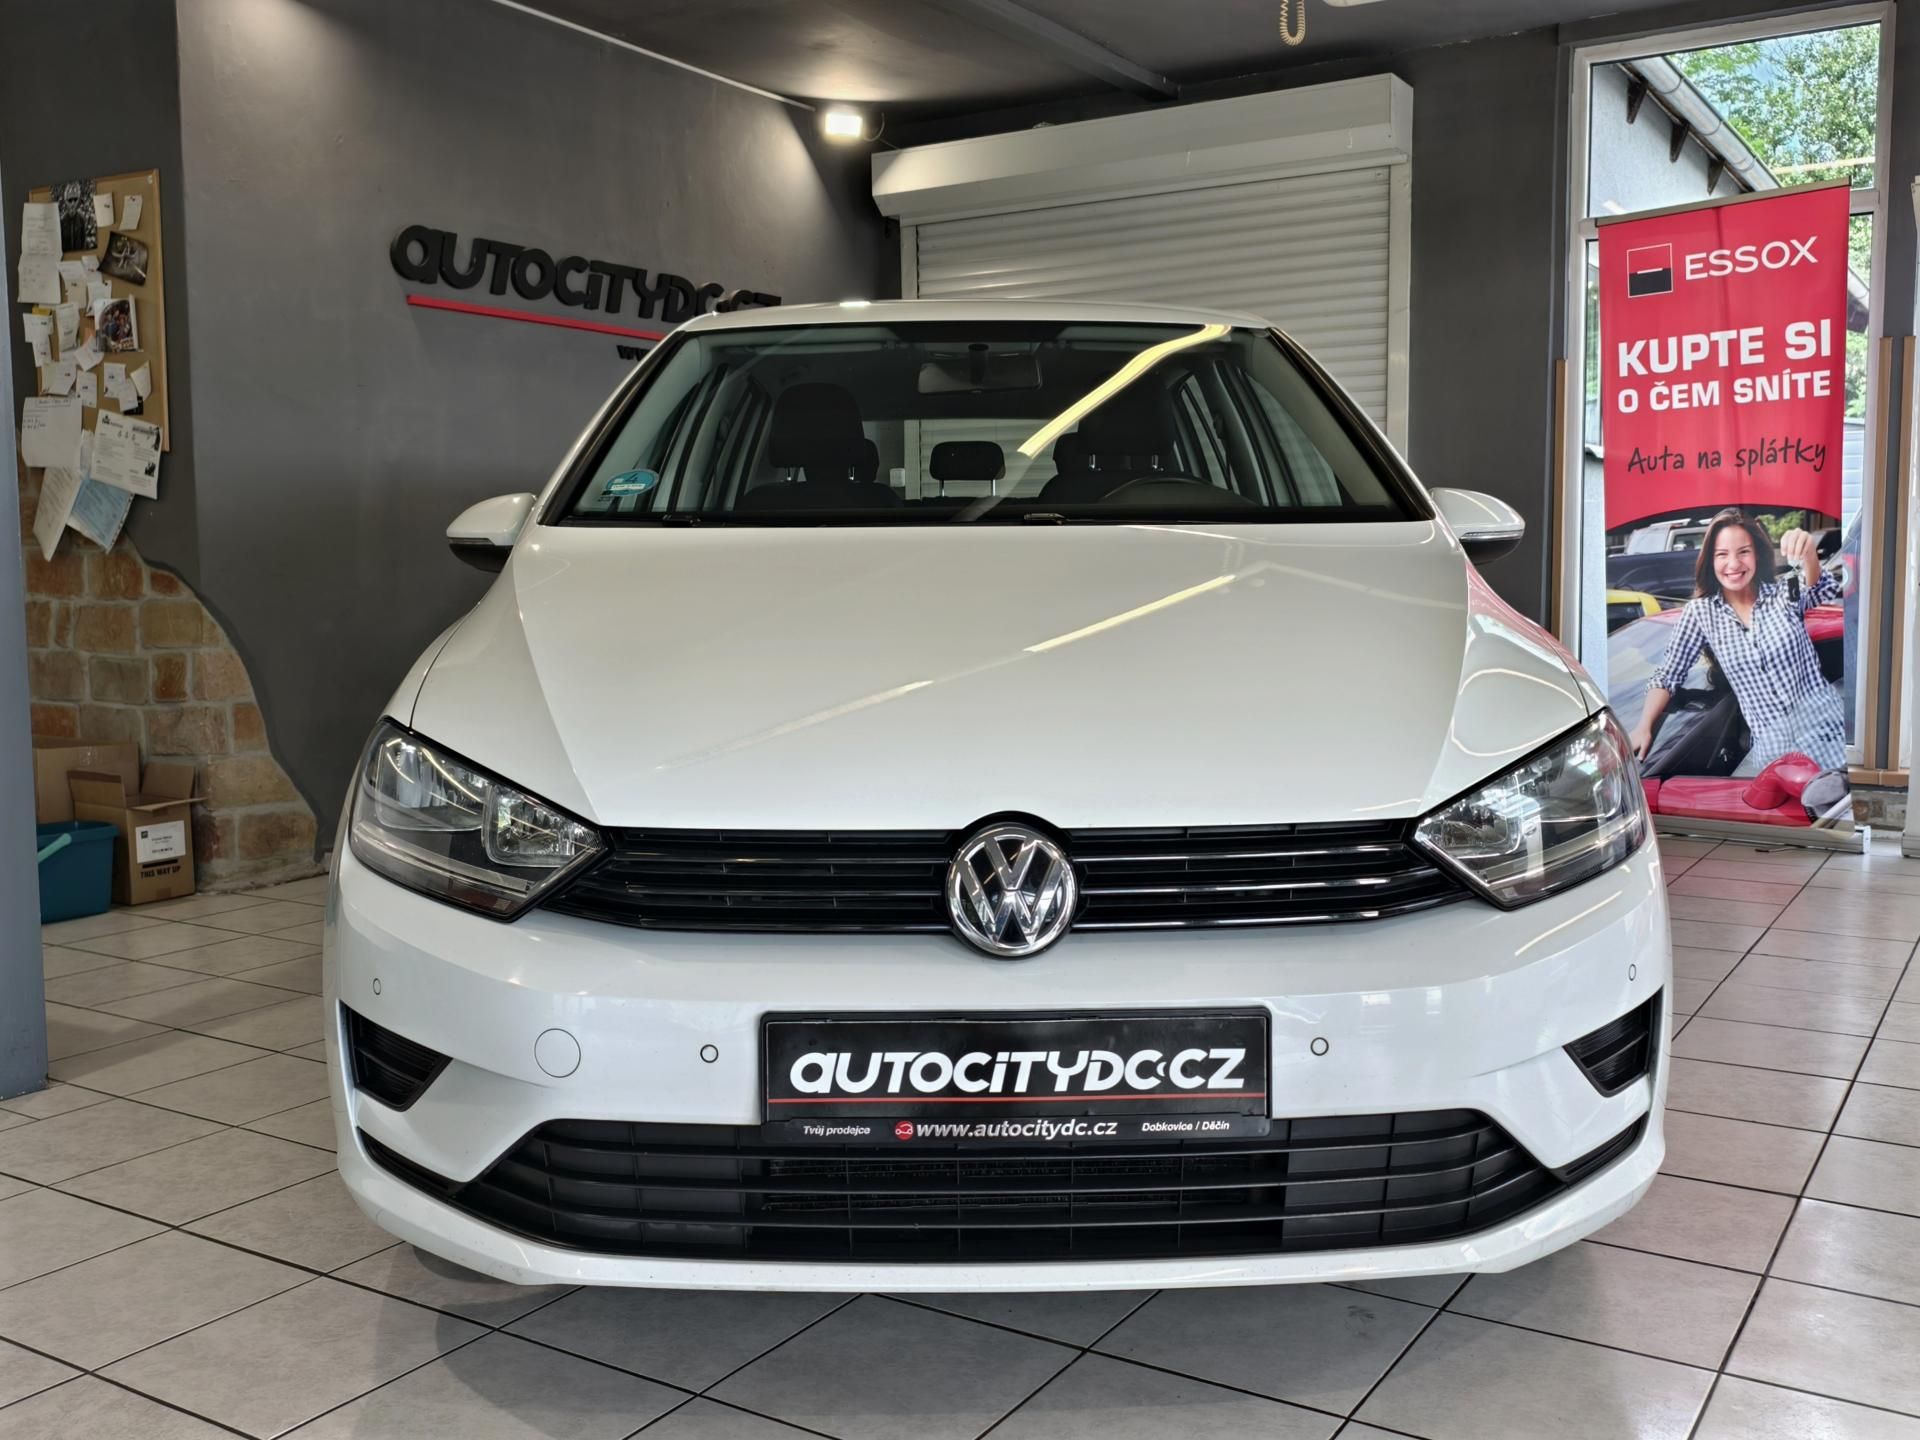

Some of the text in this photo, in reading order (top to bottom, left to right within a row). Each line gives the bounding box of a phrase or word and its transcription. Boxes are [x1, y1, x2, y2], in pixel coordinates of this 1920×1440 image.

[1685, 236, 1818, 281] ESSOX
[1618, 319, 1831, 377] KUPTE SI
[1618, 369, 1831, 413] O ČEM SNÍTE
[1627, 437, 1826, 476] Auta na splátky
[803, 1125, 825, 1136] Tvůj
[826, 1125, 871, 1136] prodejce
[916, 1119, 1118, 1140] www.autocitydc.cz
[1141, 1121, 1193, 1132] Dobkovice
[1201, 1121, 1230, 1131] Děčín
